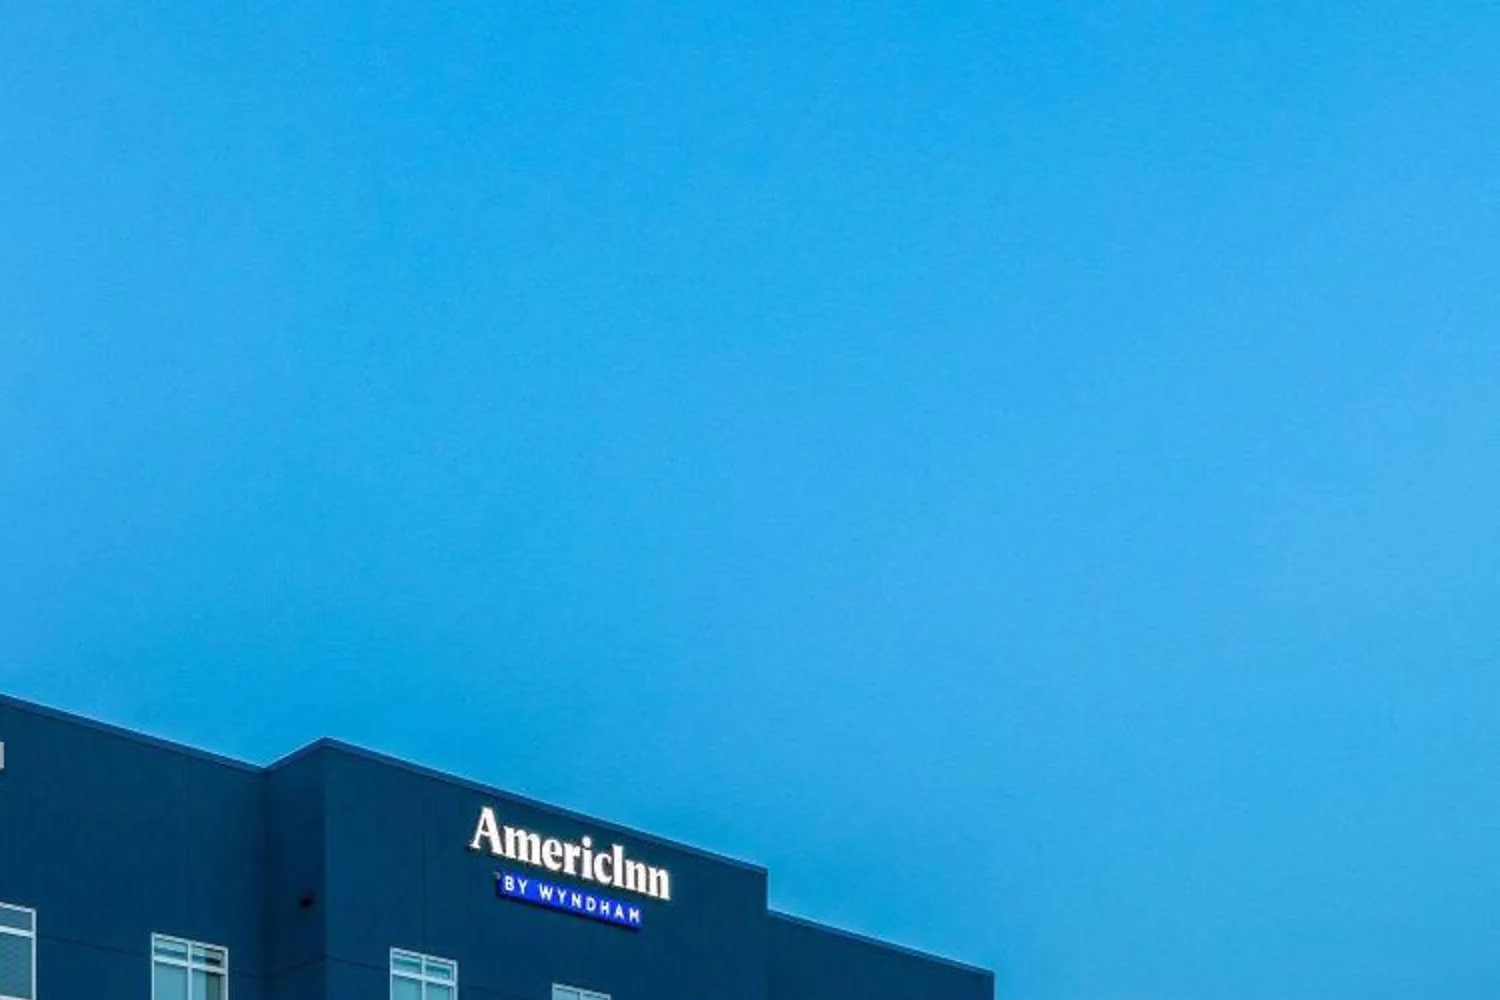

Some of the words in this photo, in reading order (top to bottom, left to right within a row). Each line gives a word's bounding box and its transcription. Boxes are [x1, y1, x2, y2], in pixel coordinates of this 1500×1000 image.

[469, 806, 671, 900] AmericInn
[504, 876, 528, 894] BY
[539, 884, 641, 923] WYNDHAM
